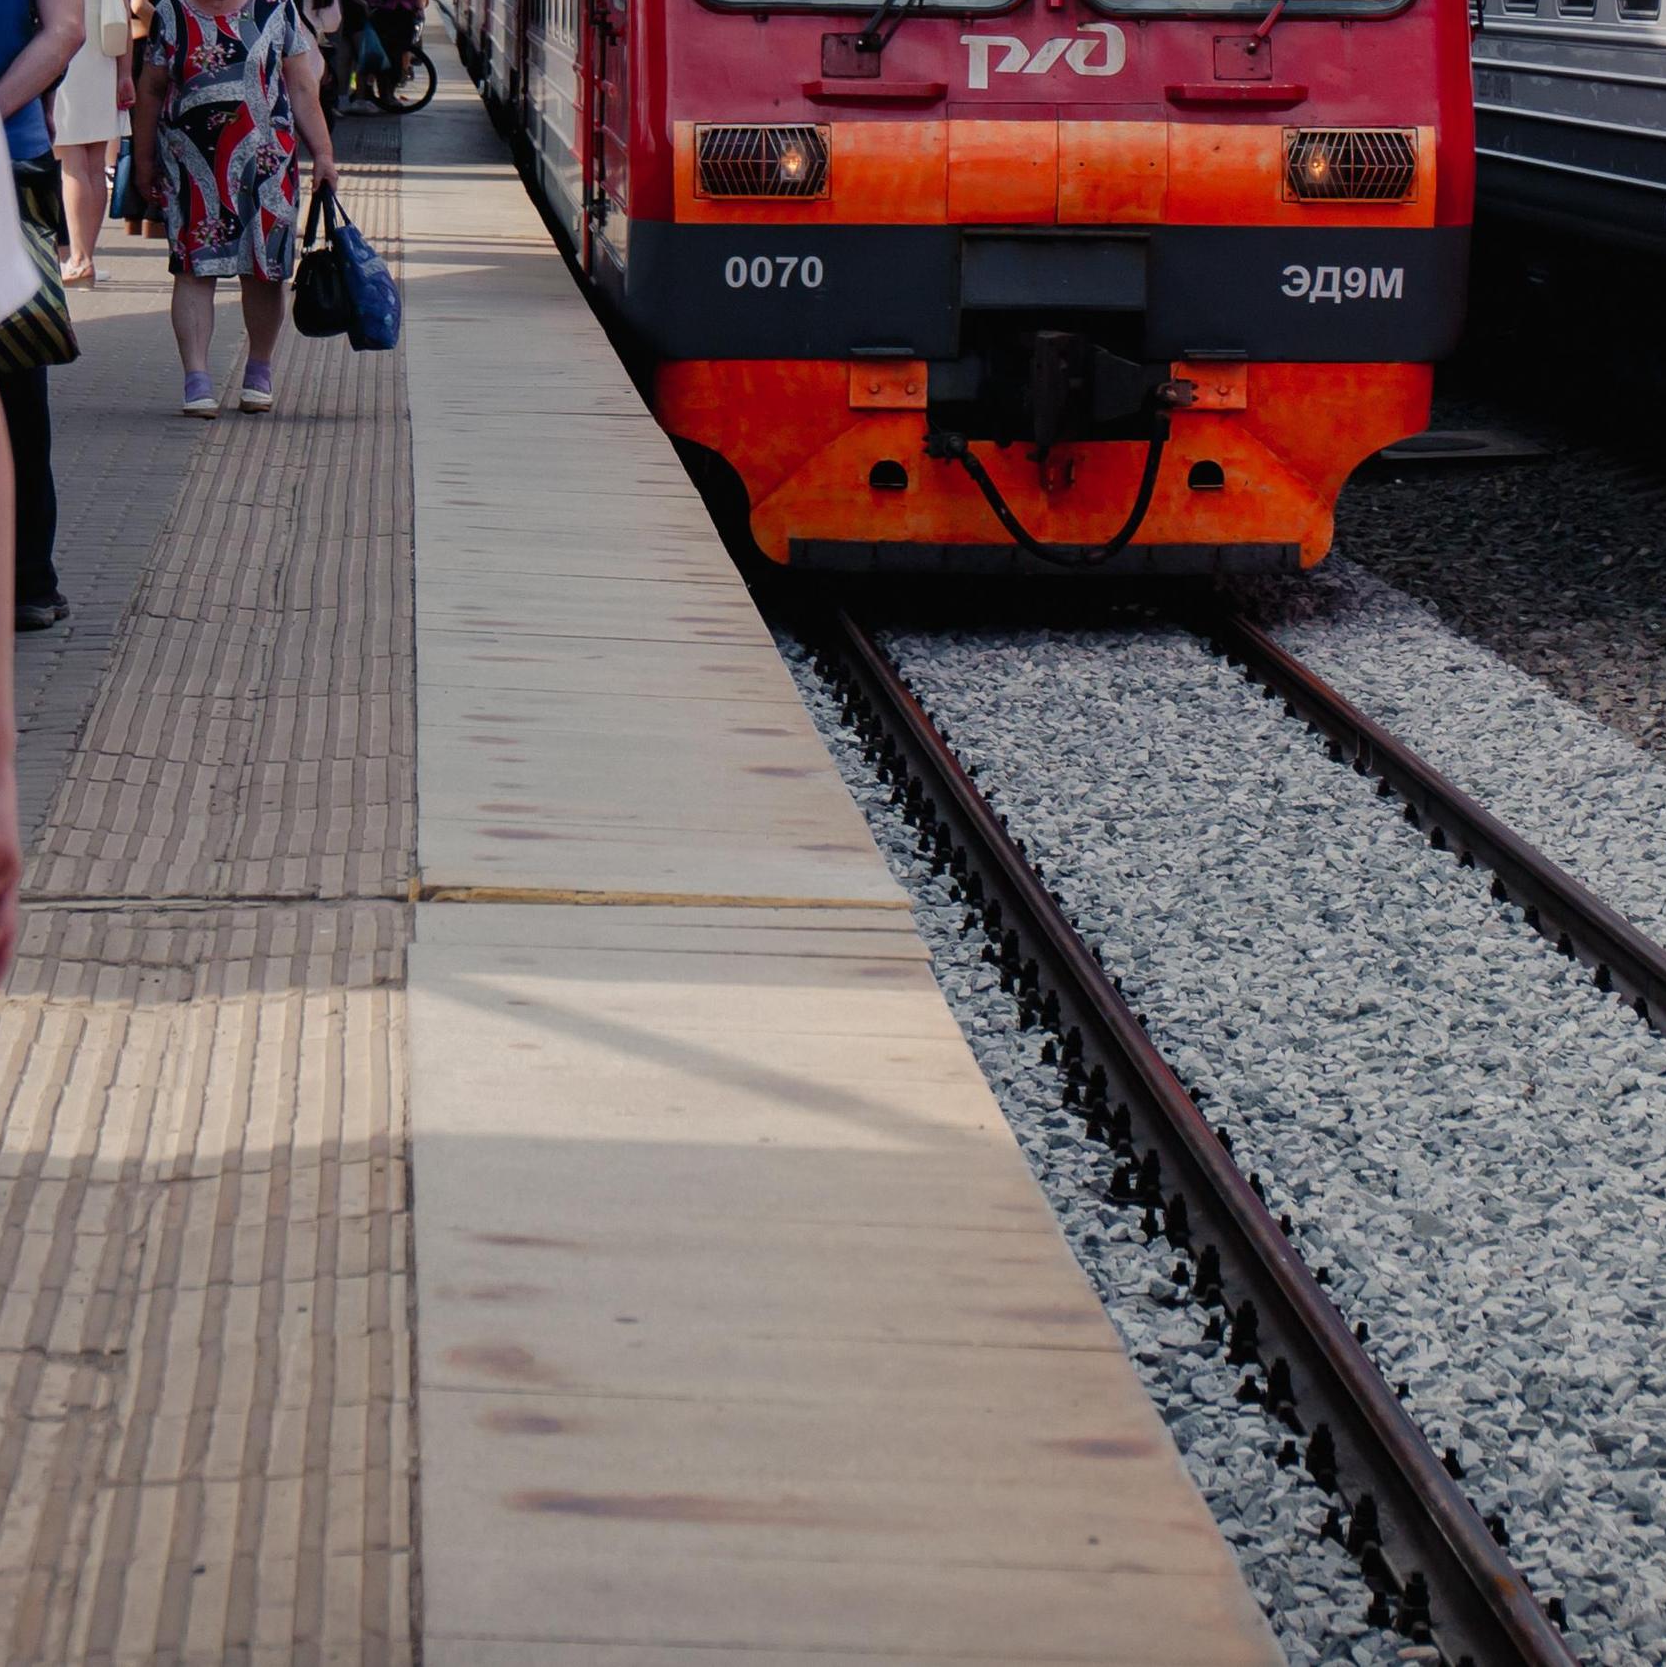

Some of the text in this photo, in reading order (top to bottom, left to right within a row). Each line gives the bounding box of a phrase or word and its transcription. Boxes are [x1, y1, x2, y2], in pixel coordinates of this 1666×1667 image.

[959, 22, 1126, 90] РЖД
[724, 255, 824, 289] 0070
[1280, 264, 1405, 304] ЭД9М
